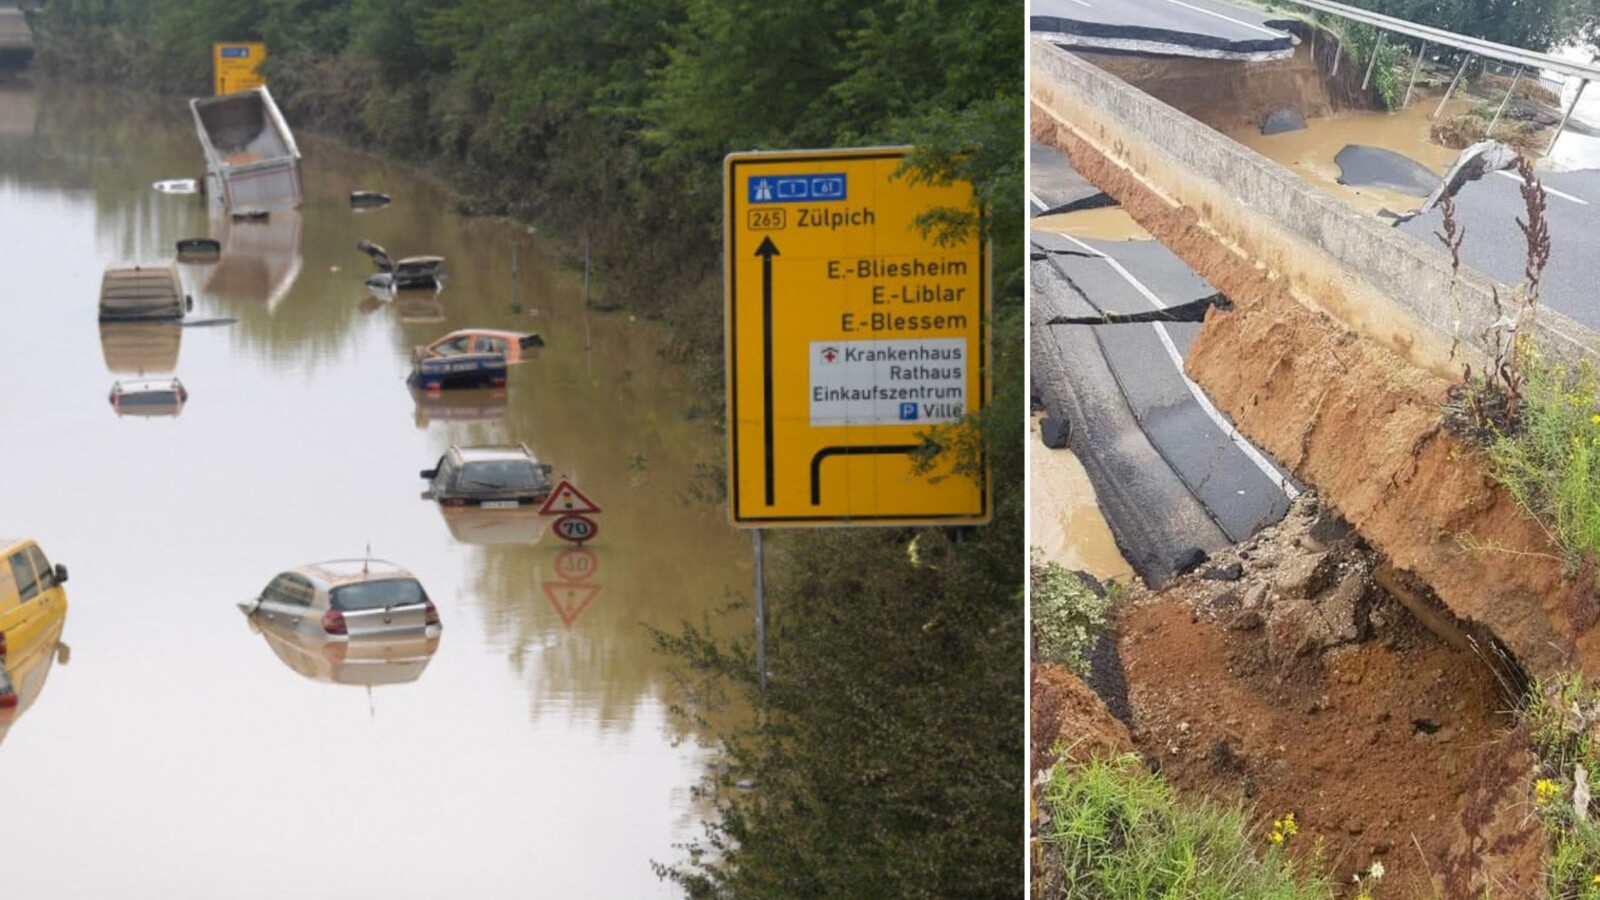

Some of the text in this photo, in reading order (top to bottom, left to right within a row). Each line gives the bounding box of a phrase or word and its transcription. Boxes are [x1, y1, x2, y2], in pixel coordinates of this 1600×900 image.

[821, 181, 833, 194] 61
[753, 206, 875, 231] 265 Zülpich
[827, 258, 967, 279] E.-Bliesheim
[872, 285, 965, 304] E.-Liblar
[841, 312, 967, 332] E.-Blessem
[845, 345, 962, 362] Krankenhaus
[890, 365, 962, 380] Rathaus
[813, 385, 962, 401] Einkaufszentrum
[923, 403, 962, 418] Ville
[563, 522, 588, 535] 70
